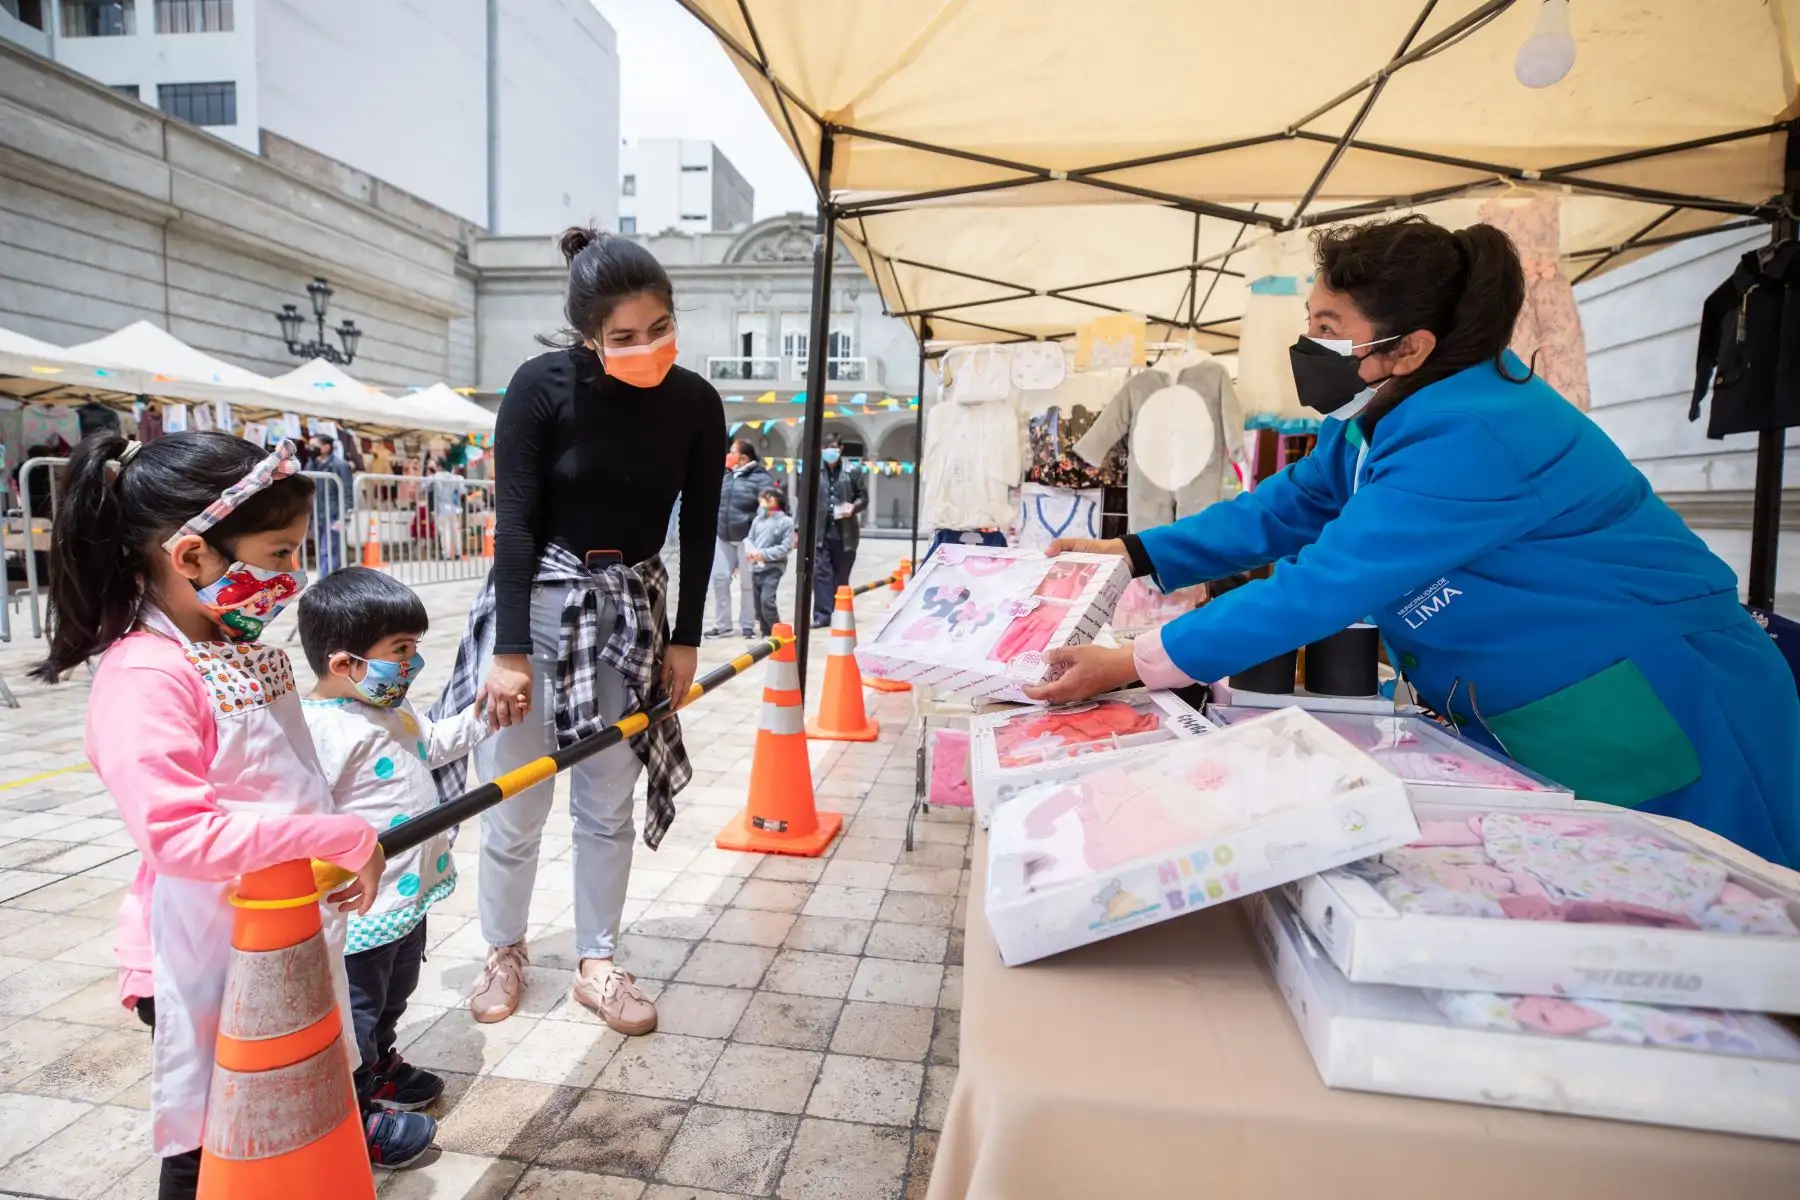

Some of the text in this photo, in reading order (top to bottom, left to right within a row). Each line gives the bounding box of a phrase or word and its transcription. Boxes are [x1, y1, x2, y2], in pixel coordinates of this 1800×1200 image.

[1397, 576, 1448, 616] MUNICIPALIDAD DE
[1404, 587, 1464, 630] LIMA
